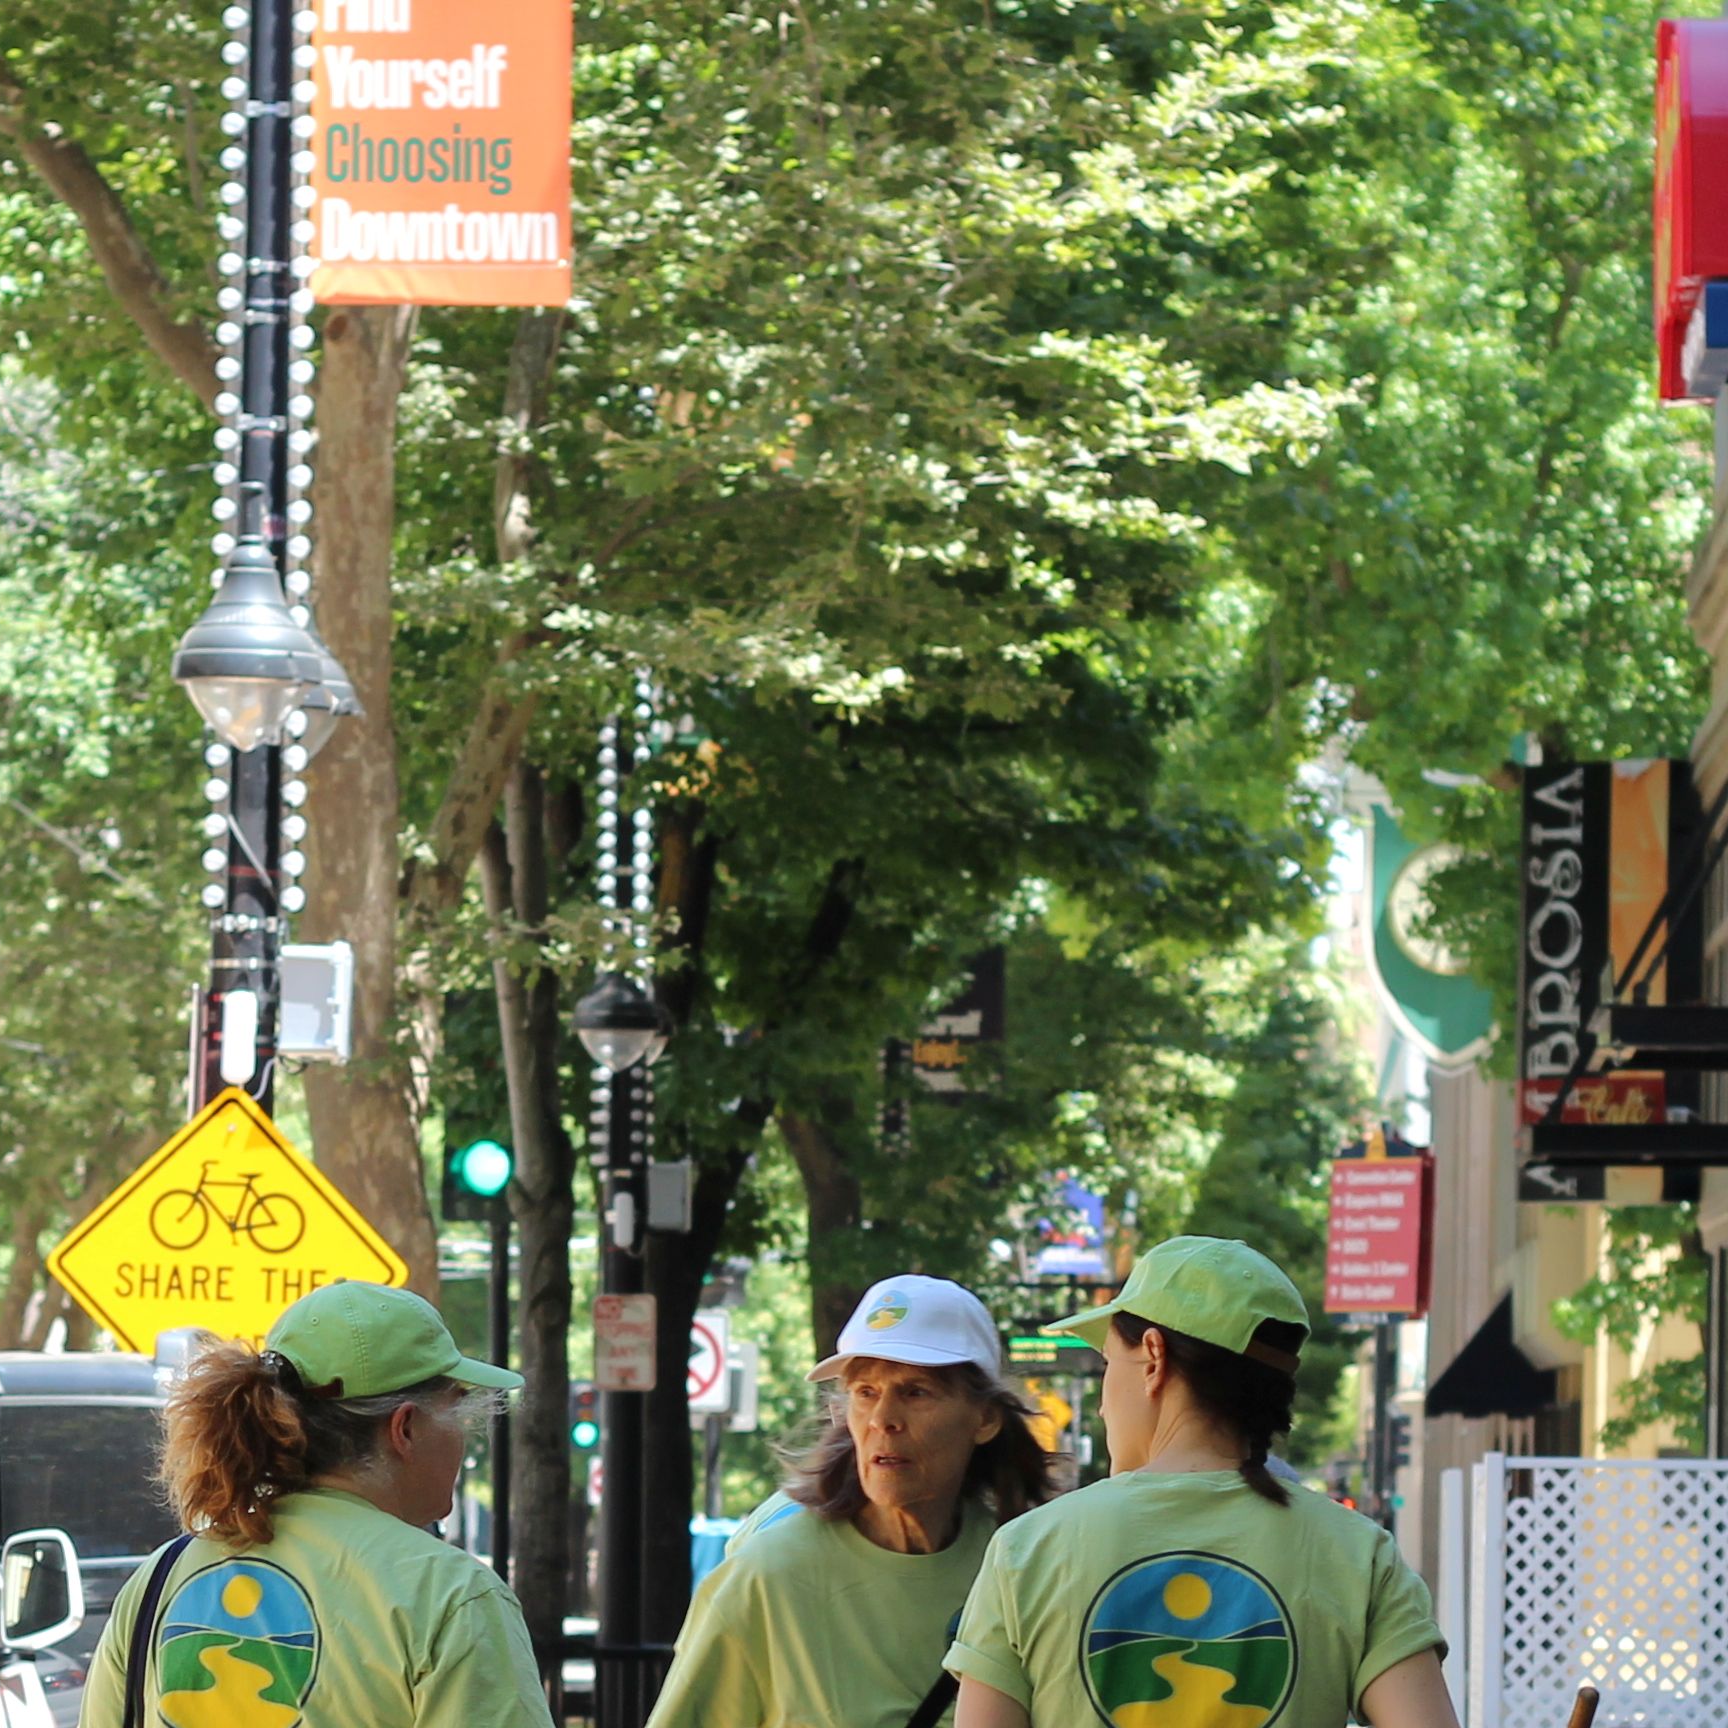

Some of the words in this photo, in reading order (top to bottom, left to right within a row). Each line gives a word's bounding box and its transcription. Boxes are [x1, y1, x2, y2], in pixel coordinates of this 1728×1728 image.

[322, 44, 509, 109] Yourself
[325, 122, 512, 195] Choosing
[321, 197, 559, 262] Downtown
[114, 1262, 235, 1302] SHARE
